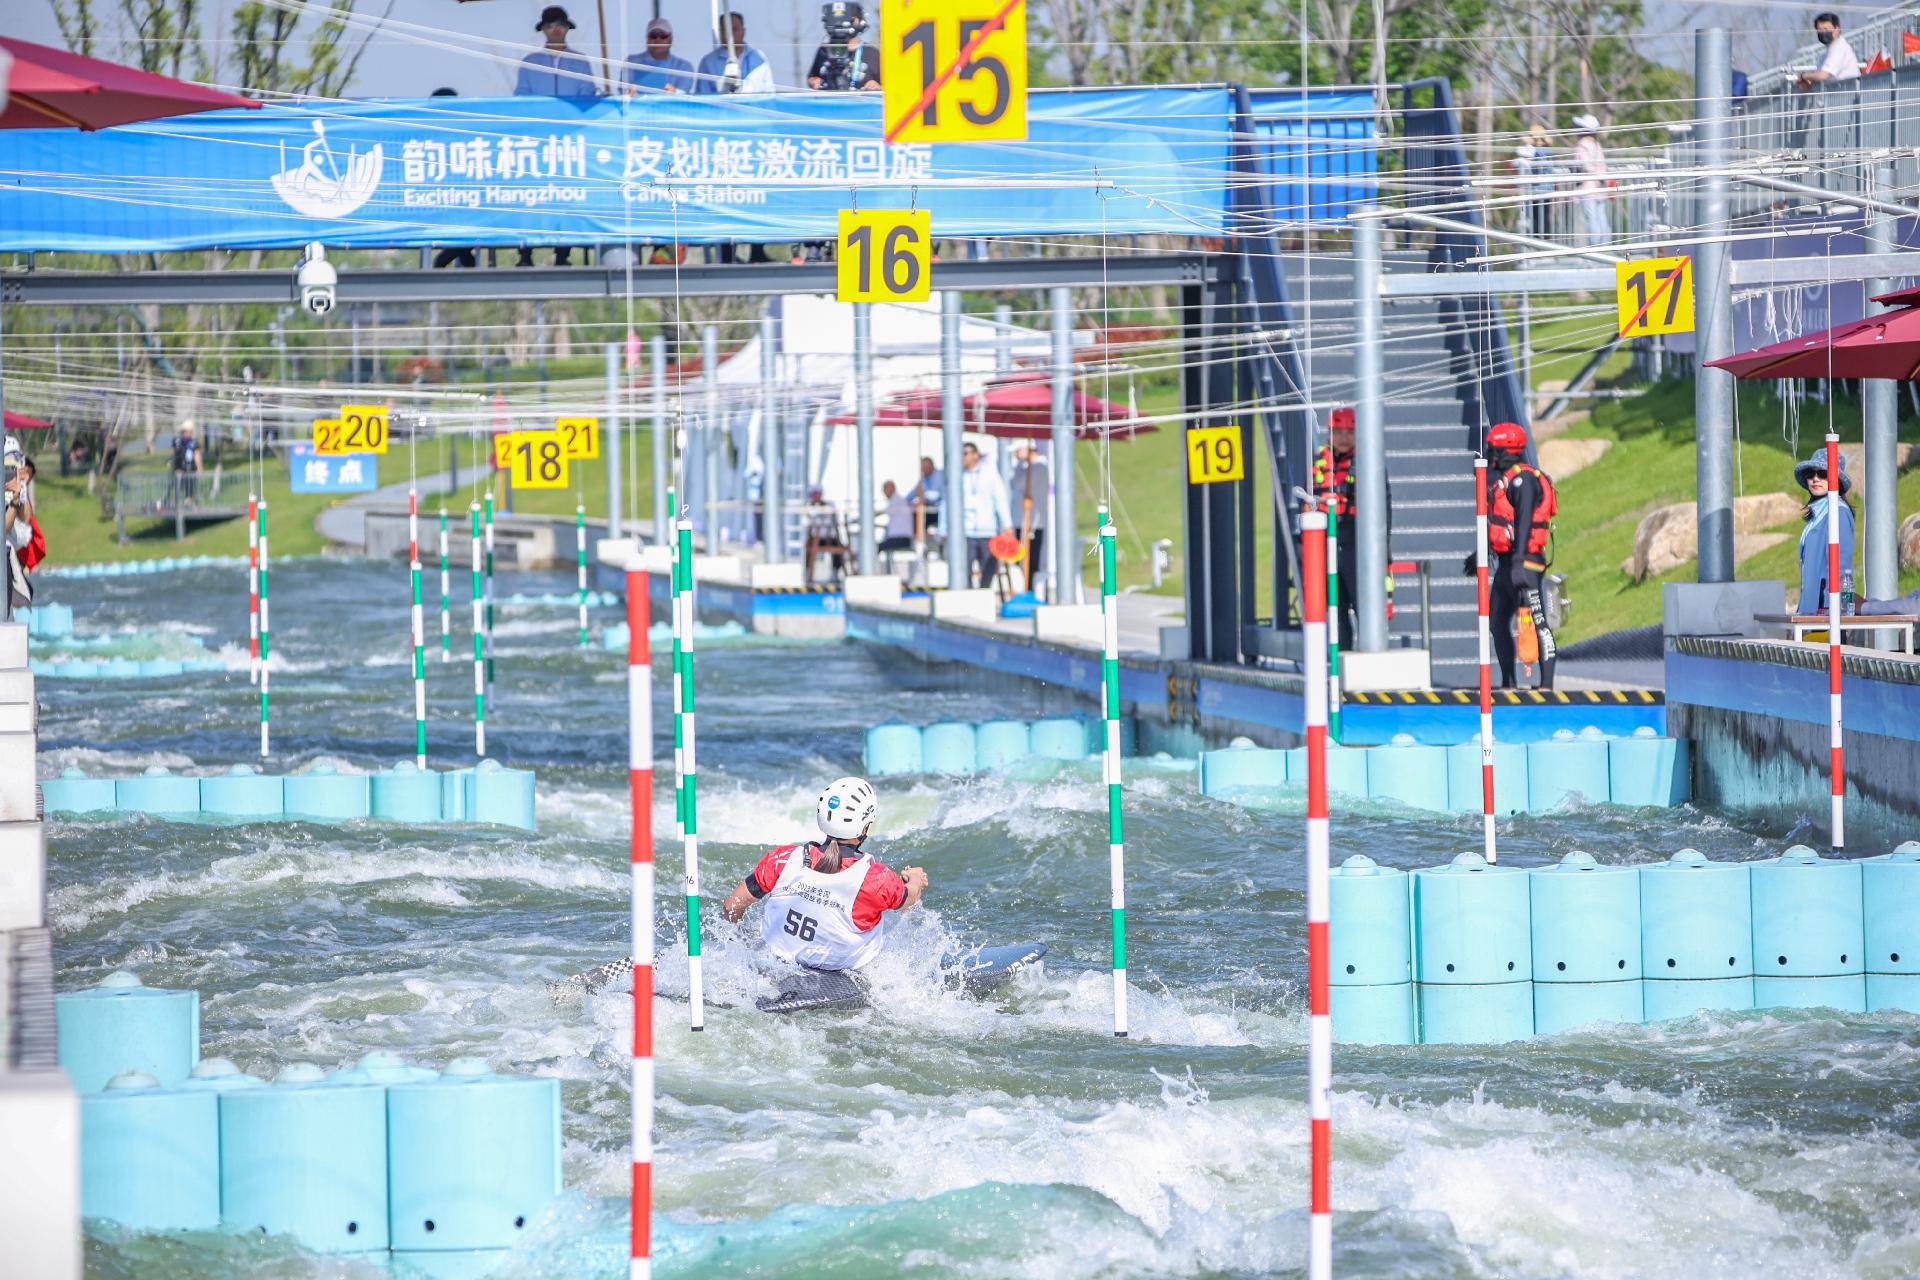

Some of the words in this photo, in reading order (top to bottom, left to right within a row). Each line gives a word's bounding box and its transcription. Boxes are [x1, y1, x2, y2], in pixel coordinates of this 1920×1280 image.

[902, 20, 1010, 126] 15
[404, 189, 480, 207] Exciting
[486, 183, 586, 206] Hangzhou
[693, 184, 767, 204] Slalom
[847, 225, 920, 294] 16
[1627, 269, 1683, 327] 17
[346, 415, 382, 447] 20
[564, 424, 591, 453] 21
[500, 440, 512, 461] 2
[517, 440, 561, 482] 18
[1196, 437, 1233, 475] 19
[1527, 589, 1541, 612] LIFE
[783, 908, 819, 942] 56
